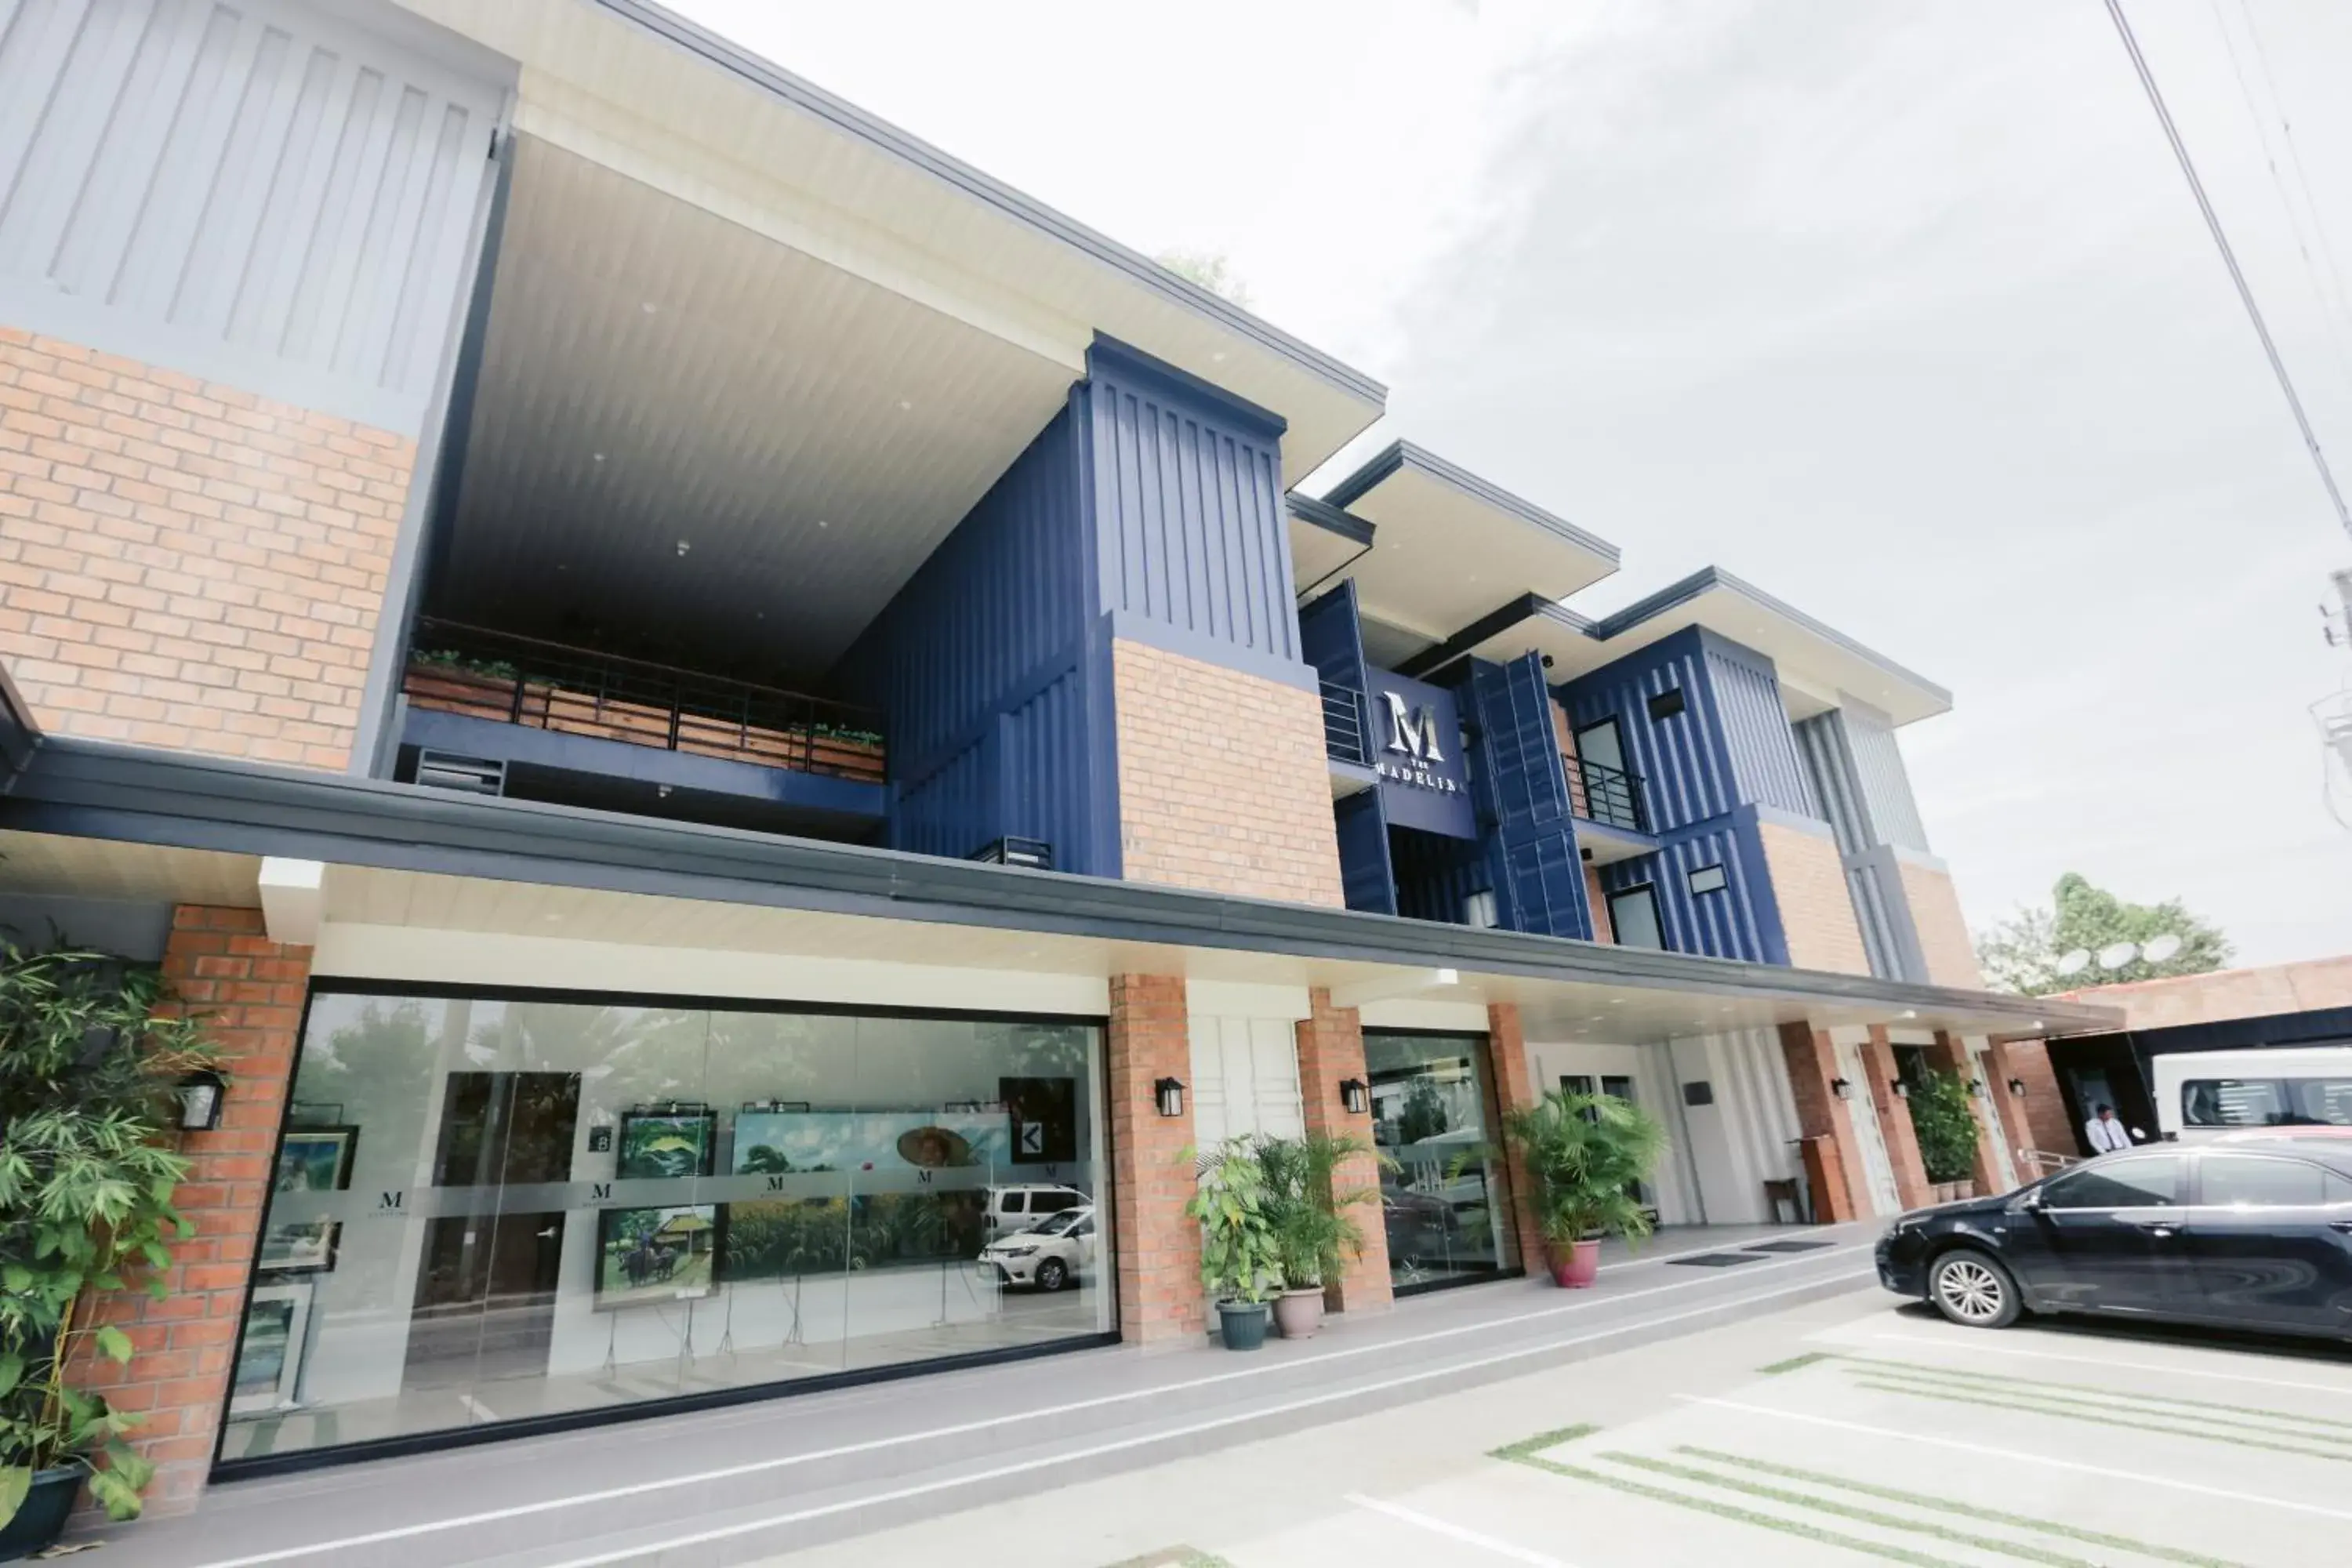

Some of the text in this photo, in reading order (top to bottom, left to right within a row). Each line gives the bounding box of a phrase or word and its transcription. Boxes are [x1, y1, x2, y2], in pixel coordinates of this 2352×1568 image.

[1383, 690, 1445, 762] M
[767, 1175, 783, 1191] M
[917, 1169, 933, 1184] M
[379, 1191, 402, 1208] M
[591, 1183, 611, 1200] M
